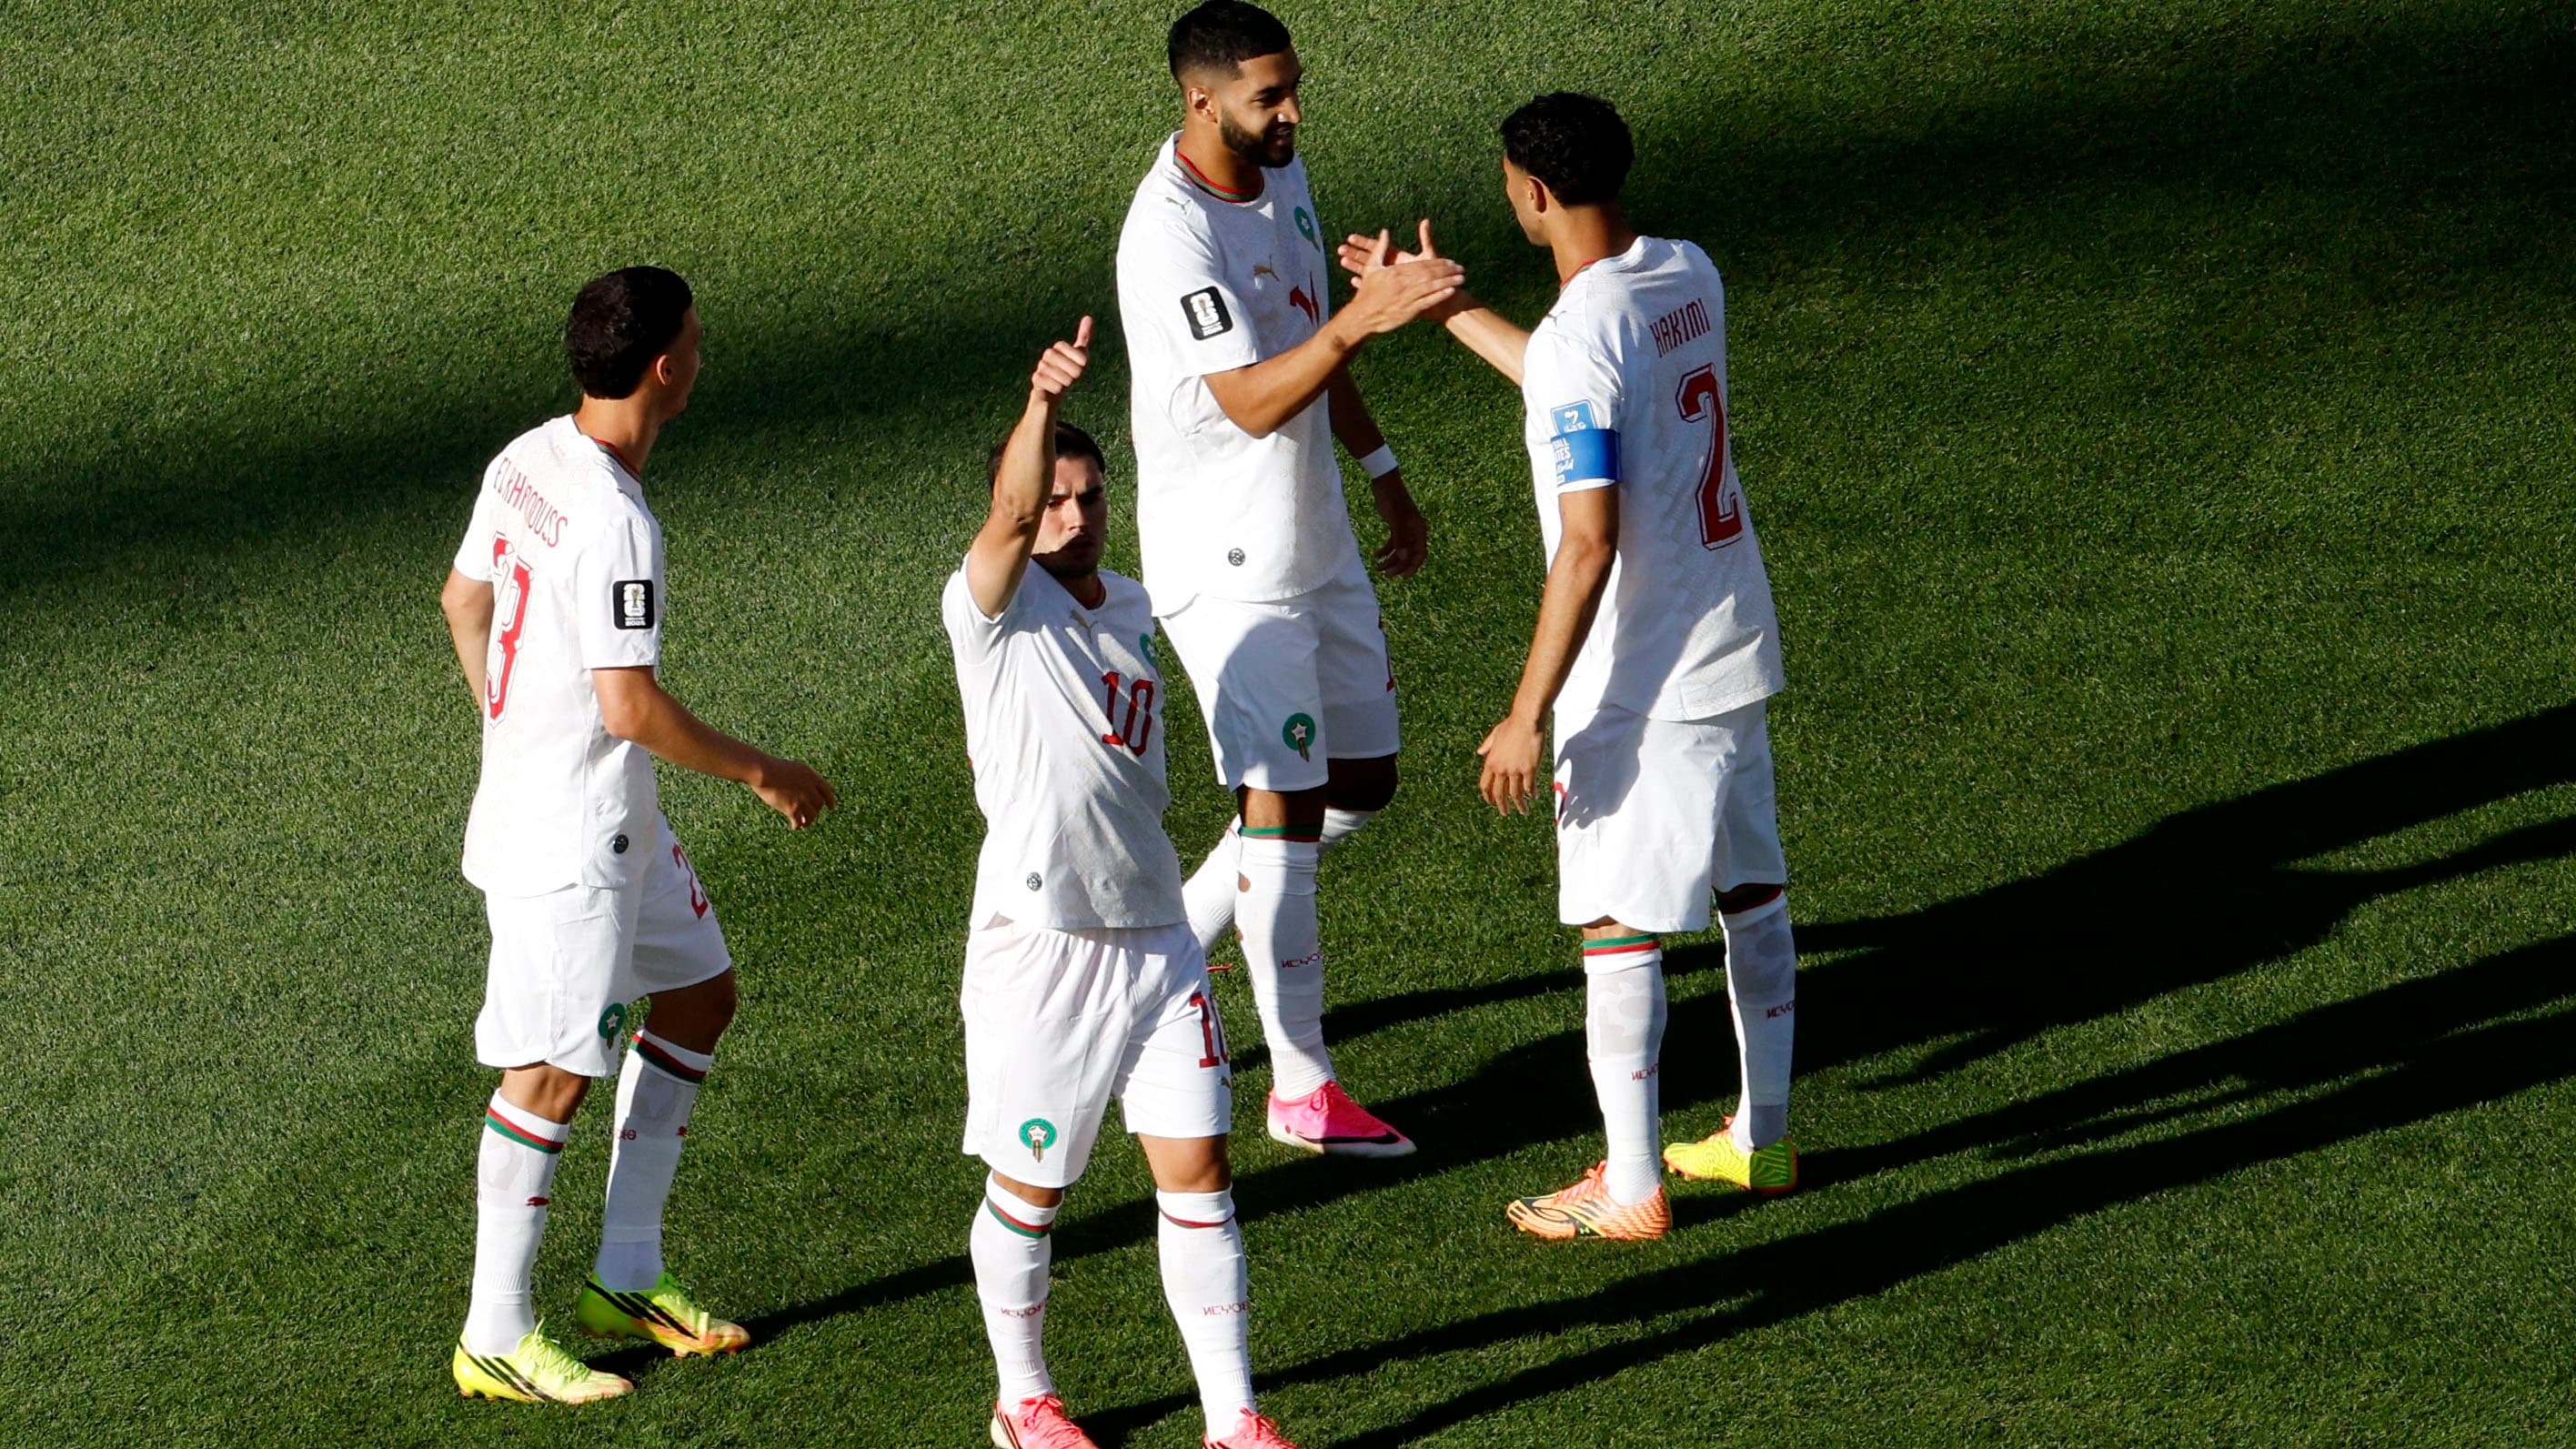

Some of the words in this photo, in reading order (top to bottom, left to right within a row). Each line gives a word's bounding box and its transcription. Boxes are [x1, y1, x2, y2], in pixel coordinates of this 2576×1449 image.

[1648, 297, 1711, 359] HAKIMI
[1675, 361, 1744, 551] 2
[1101, 670, 1154, 758] 10
